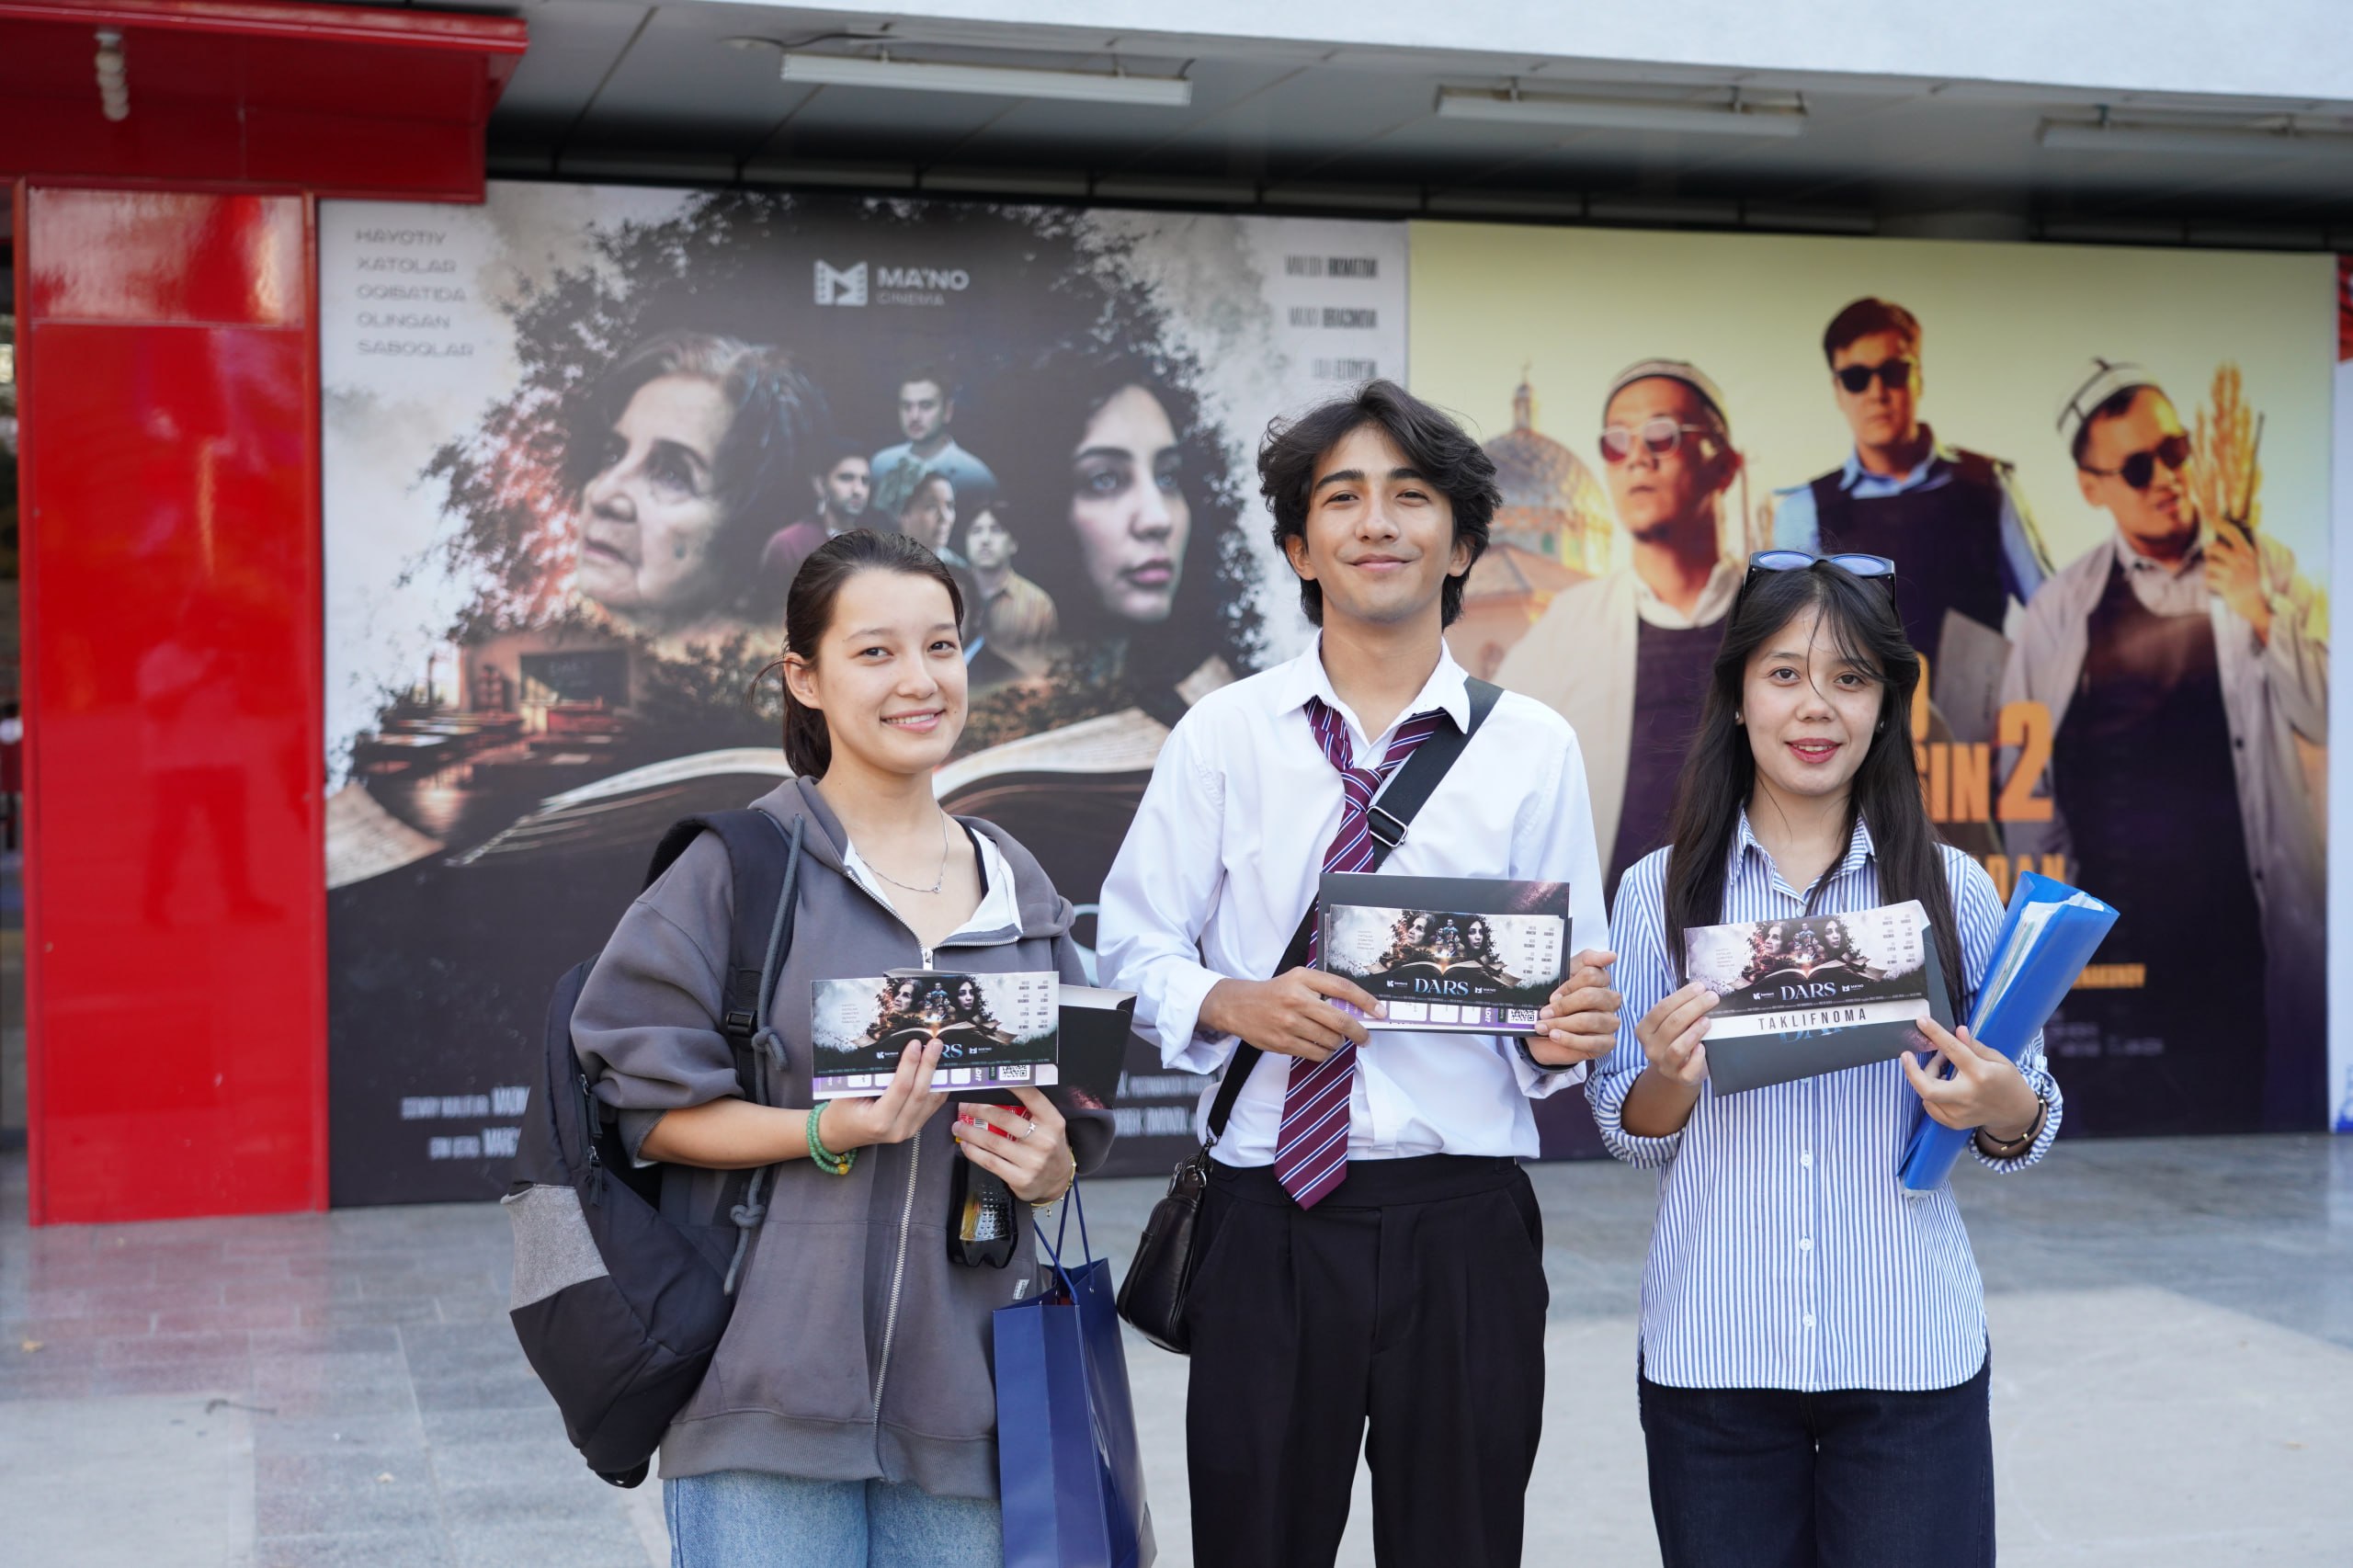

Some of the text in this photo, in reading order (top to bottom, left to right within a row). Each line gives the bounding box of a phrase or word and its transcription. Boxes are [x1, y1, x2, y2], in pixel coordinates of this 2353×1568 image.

[876, 291, 945, 306] CINEMA
[1995, 699, 2054, 823] 2
[1415, 978, 1469, 996] DARS
[1780, 982, 1836, 1001] DARS
[1758, 1007, 1867, 1030] TAKLIFNOMA
